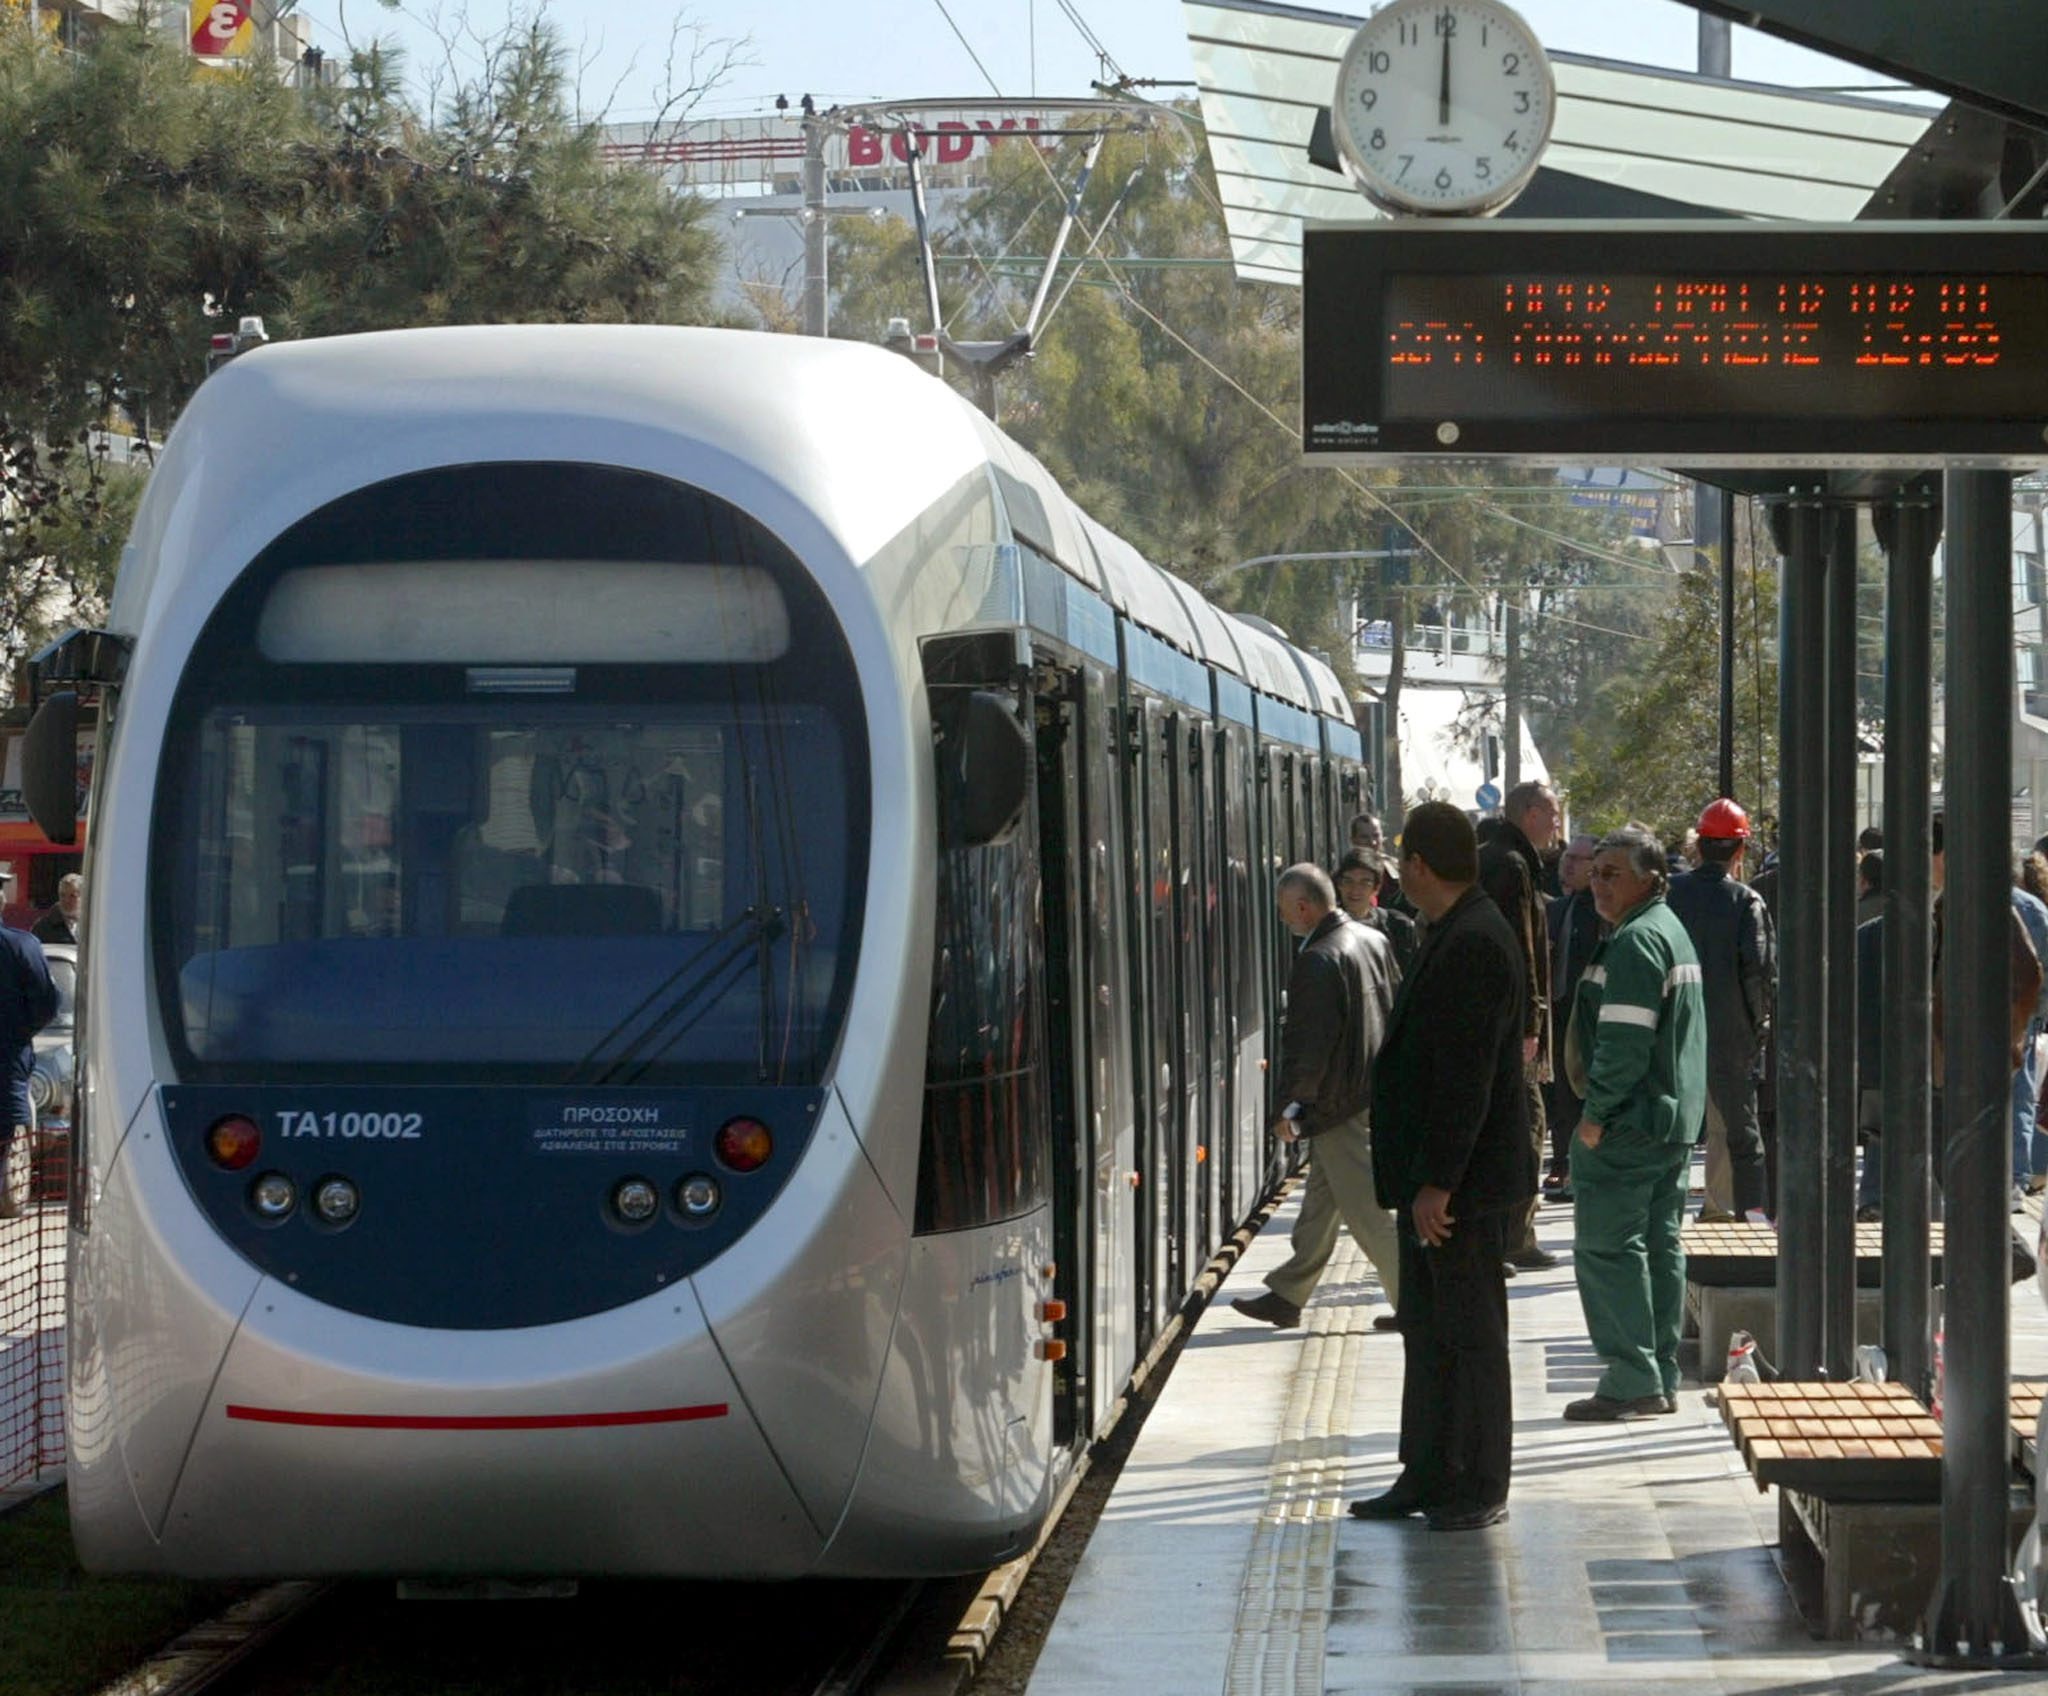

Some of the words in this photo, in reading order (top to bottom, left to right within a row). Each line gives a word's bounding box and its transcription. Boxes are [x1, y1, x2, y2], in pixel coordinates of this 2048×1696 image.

[1400, 23, 1418, 46] 11
[1434, 14, 1457, 38] 12
[1481, 24, 1488, 47] 1
[1368, 51, 1390, 74] 10
[1502, 53, 1520, 76] 2
[1360, 89, 1377, 112] 9
[1513, 91, 1530, 114] 3
[1370, 128, 1386, 151] 8
[1503, 130, 1519, 152] 4
[1398, 155, 1415, 178] 7
[1434, 166, 1452, 190] 6
[1475, 157, 1491, 179] 5
[275, 1111, 424, 1139] TA10002
[563, 1107, 660, 1123] ΠΡΟΣΟΧΗ
